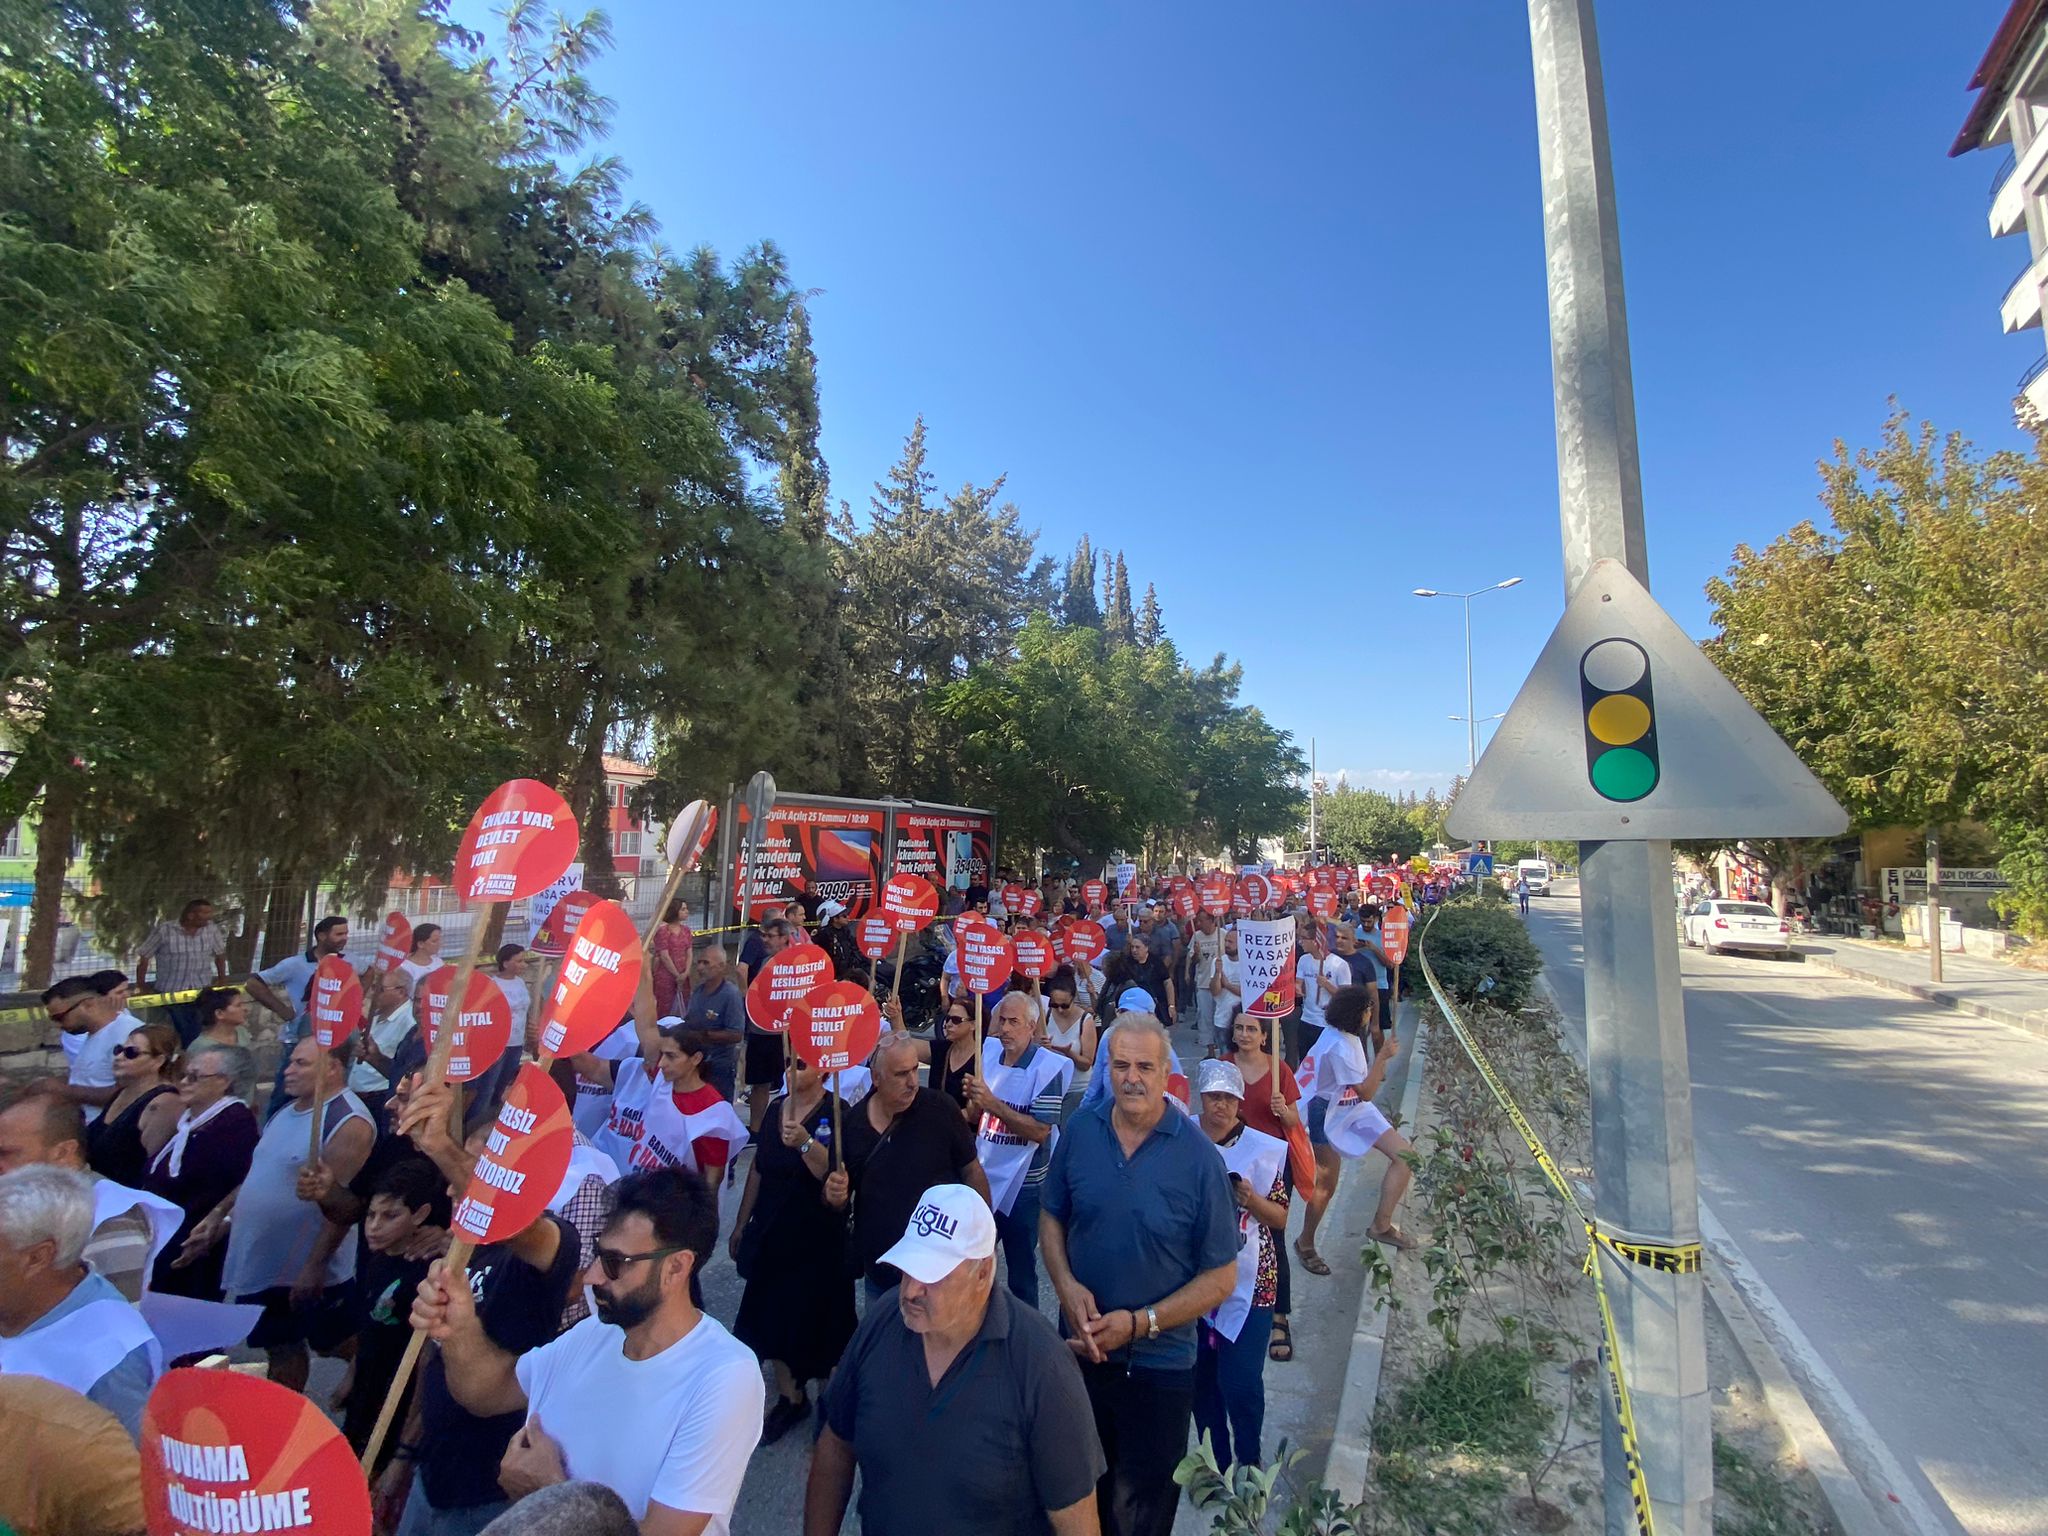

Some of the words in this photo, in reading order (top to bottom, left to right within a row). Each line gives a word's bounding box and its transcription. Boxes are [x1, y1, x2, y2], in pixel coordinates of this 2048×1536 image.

[482, 811, 520, 829] ENKAZ
[522, 811, 555, 831] VAR,
[808, 812, 817, 821] 25
[818, 813, 847, 823] Temmuz
[851, 814, 869, 824] 10:00
[476, 830, 520, 849] DEVLET
[897, 839, 930, 848] MediaMarkt
[470, 849, 498, 868] YOK!
[896, 848, 937, 860] İskenderun
[739, 866, 766, 880] Prk
[766, 865, 802, 880] Forbes
[896, 861, 913, 873] Park
[913, 861, 937, 872] Forbes
[486, 880, 516, 890] HAKKI
[1245, 930, 1294, 946] REZERV
[978, 945, 1005, 956] YASASI,
[592, 945, 621, 975] VAR,
[773, 964, 794, 976] KİRA
[795, 959, 826, 975] DESTEĞİ
[812, 1006, 842, 1018] ENKAZ
[844, 1003, 864, 1016] VAR,
[811, 1020, 845, 1032] DEVLET
[811, 1036, 833, 1046] YOK!
[983, 1131, 1029, 1147] PLATFORMU
[466, 1208, 492, 1230] HAKKI
[161, 1434, 250, 1483] YUVAMA
[167, 1483, 313, 1534] KÜLTÜRÜME
